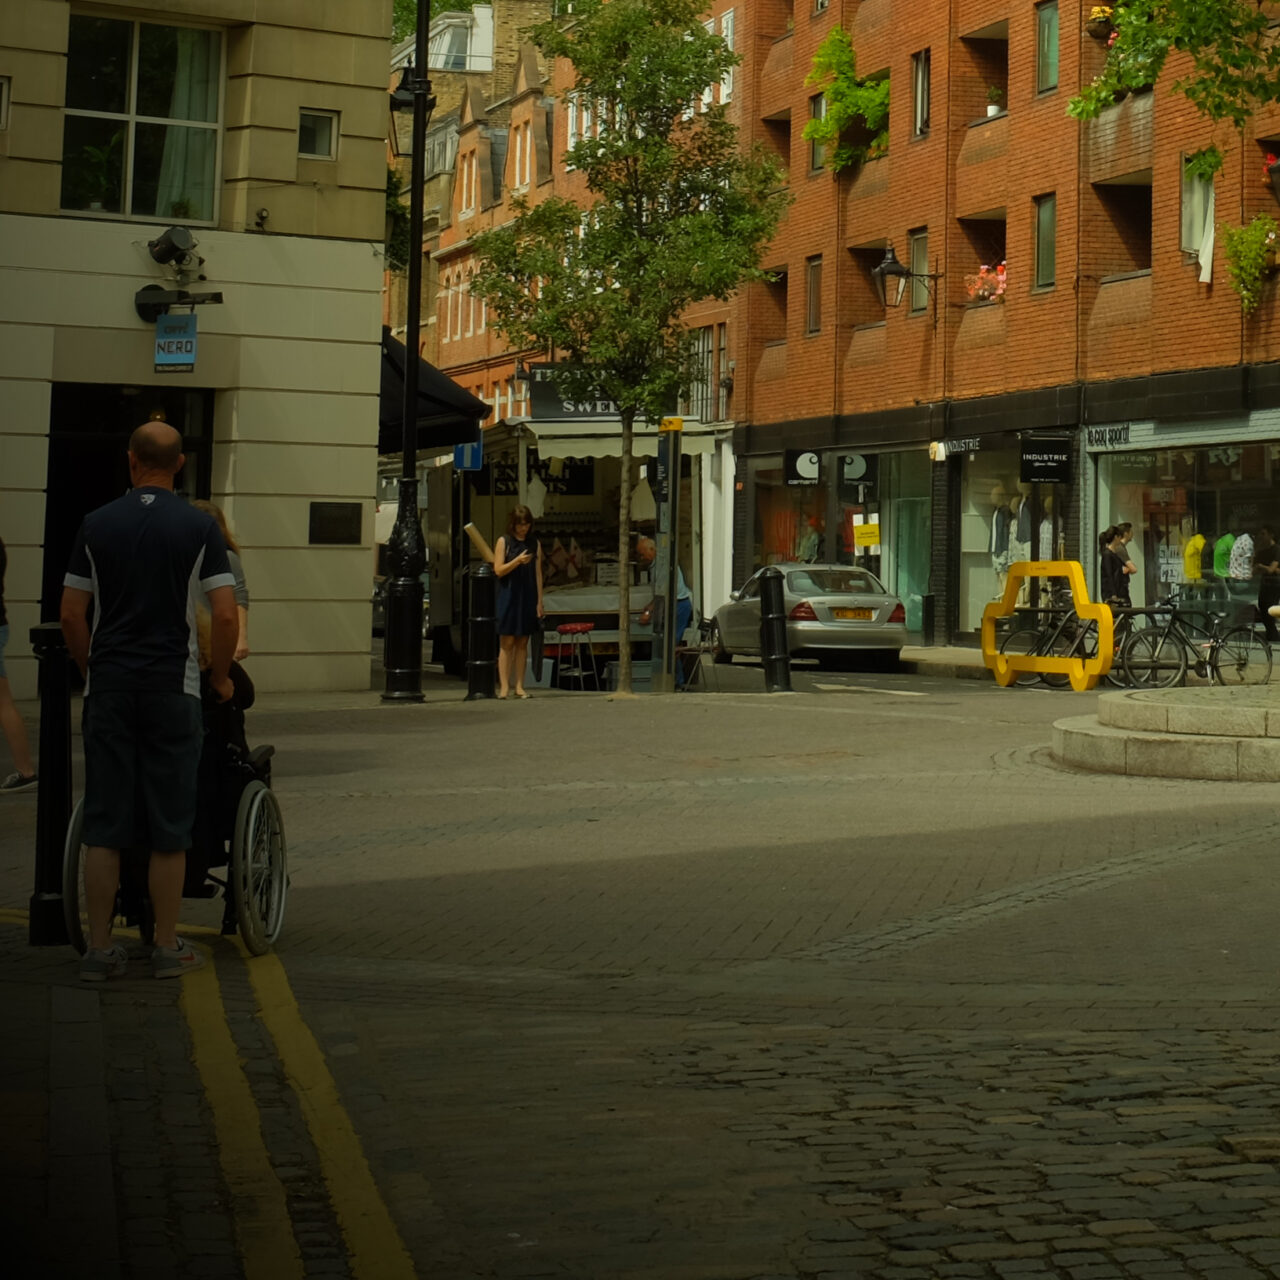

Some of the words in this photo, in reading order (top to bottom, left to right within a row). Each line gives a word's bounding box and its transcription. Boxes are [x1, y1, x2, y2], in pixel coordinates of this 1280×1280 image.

[157, 341, 193, 354] NERO
[1095, 428, 1108, 449] coq
[1108, 422, 1129, 448] sportif
[1022, 453, 1068, 461] INDUSTRIE
